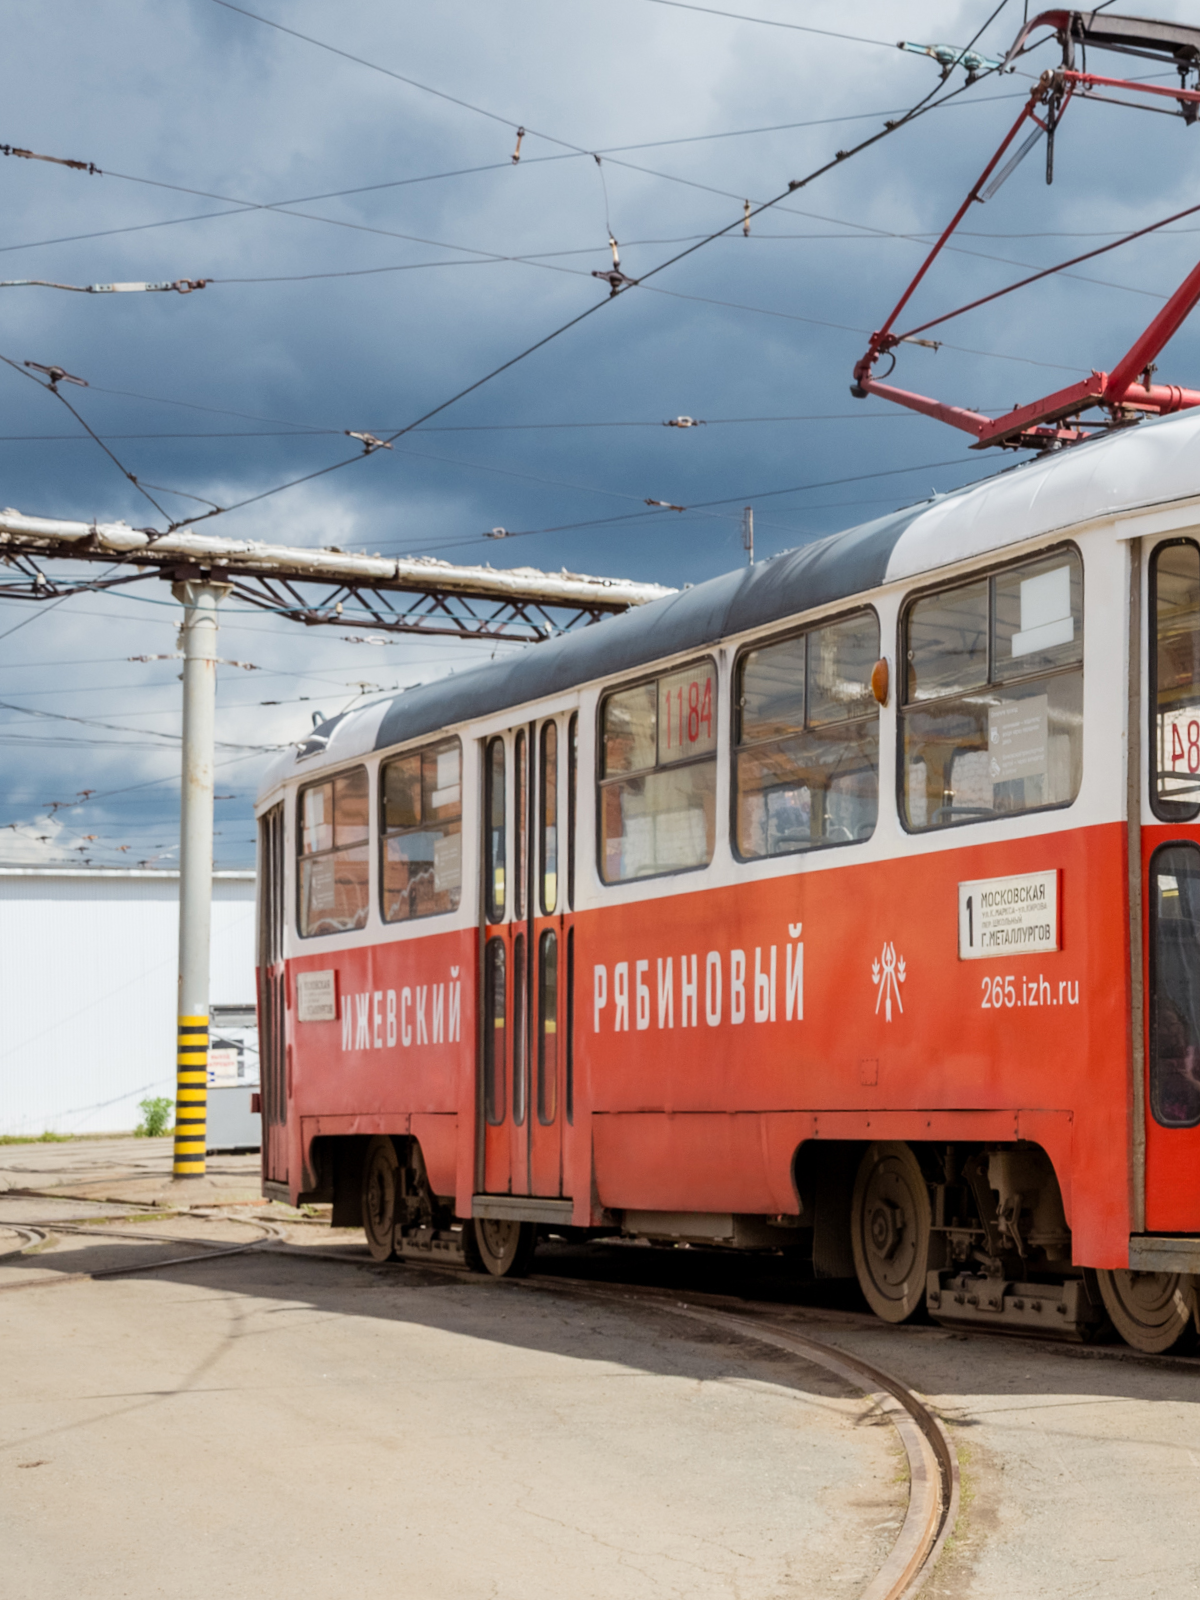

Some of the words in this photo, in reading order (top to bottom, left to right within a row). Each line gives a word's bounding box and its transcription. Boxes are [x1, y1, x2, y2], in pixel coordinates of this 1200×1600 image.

[665, 677, 712, 749] 1184
[966, 895, 973, 947] 1
[981, 884, 1046, 908] МОСКОВСКАЯ
[341, 965, 461, 1051] ИЖЕВСКИЙ
[594, 922, 804, 1033] РЯБИНОВЫЙ
[981, 974, 1080, 1008] 265.izh.ru
